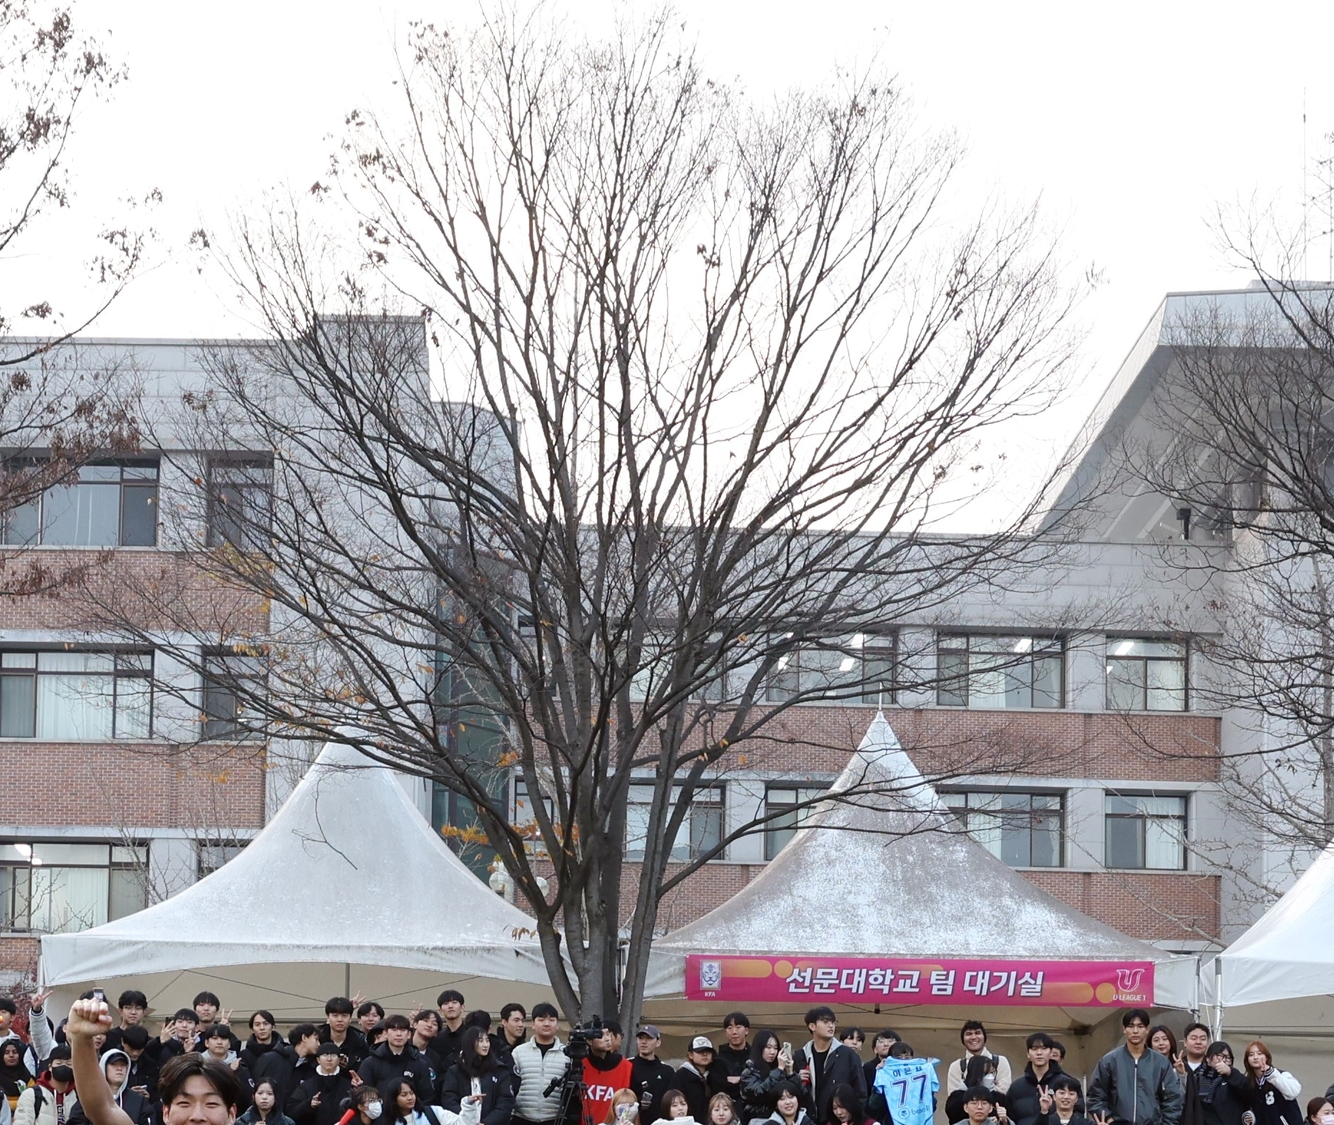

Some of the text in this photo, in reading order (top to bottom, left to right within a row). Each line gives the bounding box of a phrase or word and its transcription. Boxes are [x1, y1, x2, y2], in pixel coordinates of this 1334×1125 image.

[786, 967, 1045, 998] 선문대학교 팀 대기실
[584, 1084, 615, 1102] KFA
[890, 1073, 927, 1107] 77
